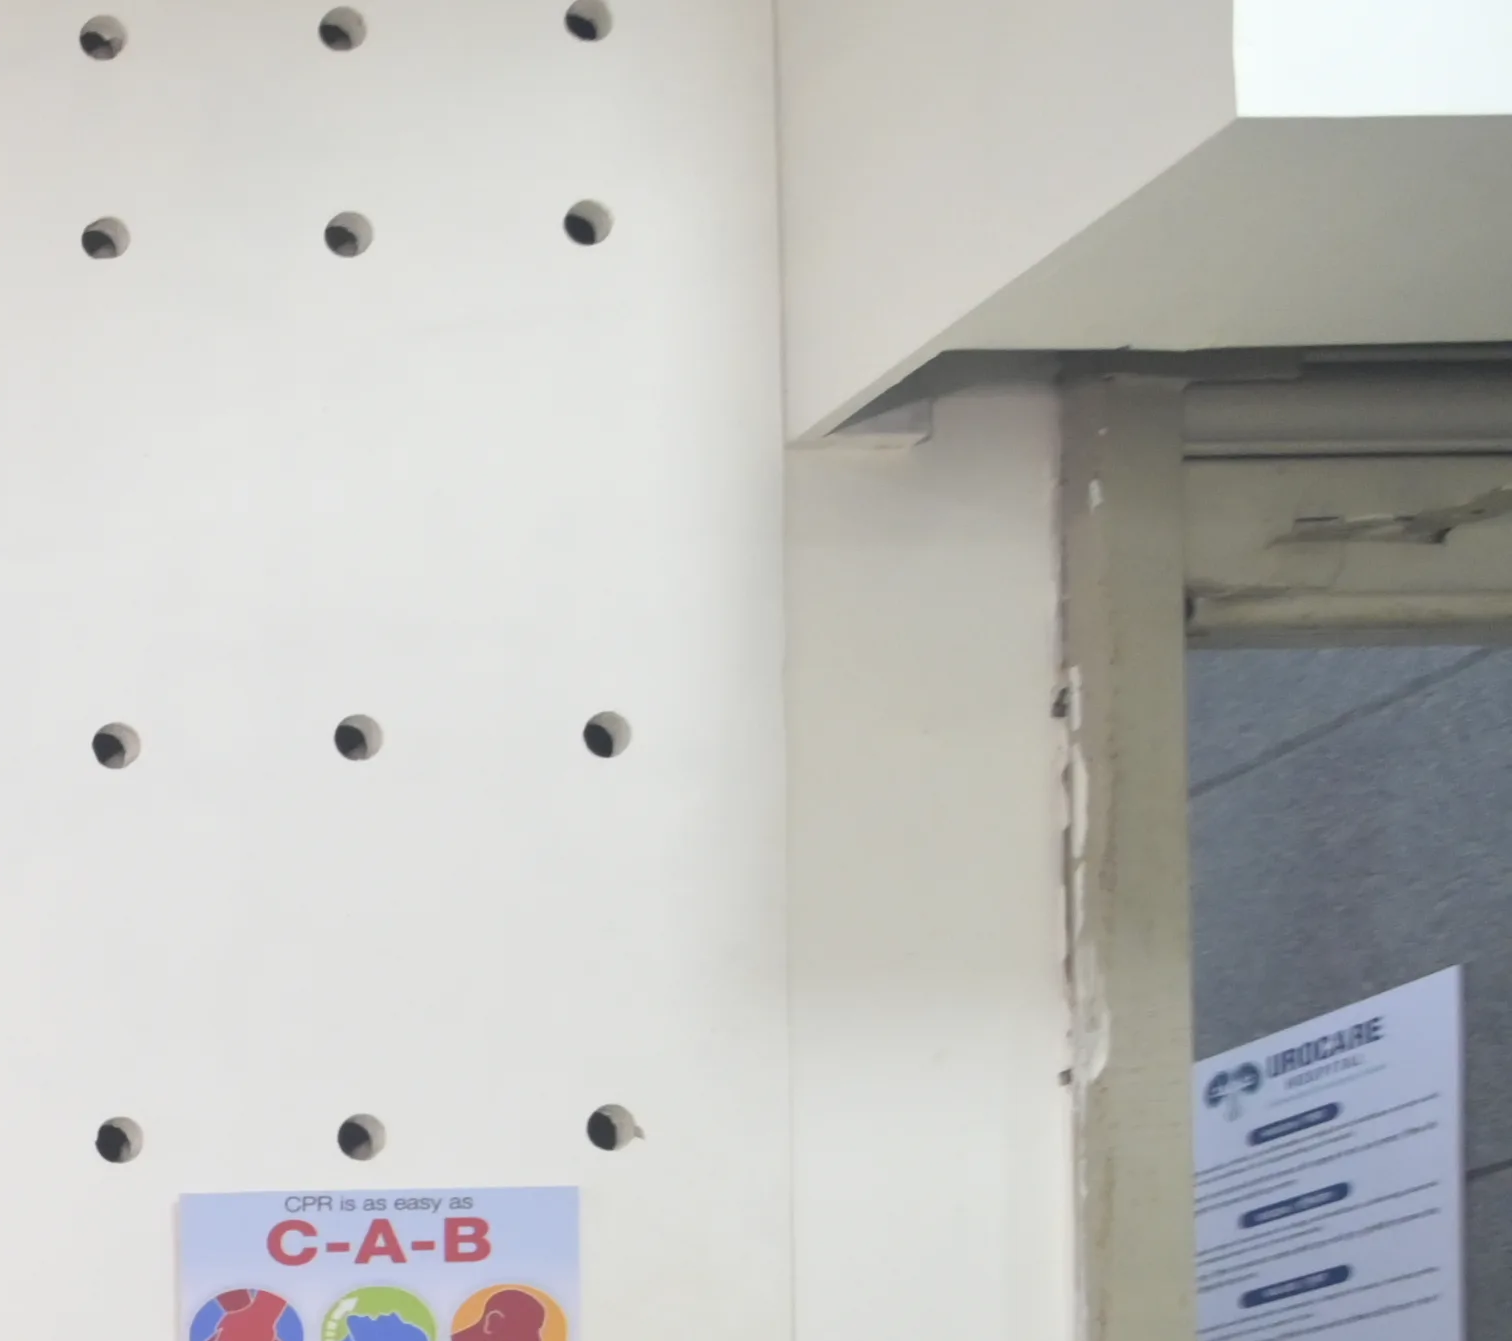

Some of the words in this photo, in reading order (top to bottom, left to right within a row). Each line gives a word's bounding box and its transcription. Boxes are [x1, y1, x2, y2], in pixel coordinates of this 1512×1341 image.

[1266, 1016, 1386, 1078] UROCARE
[284, 1197, 333, 1212] CPR
[340, 1196, 356, 1211] is
[362, 1198, 387, 1211] as
[394, 1197, 441, 1213] easy
[449, 1196, 473, 1210] as
[266, 1217, 492, 1266] C-A-B
